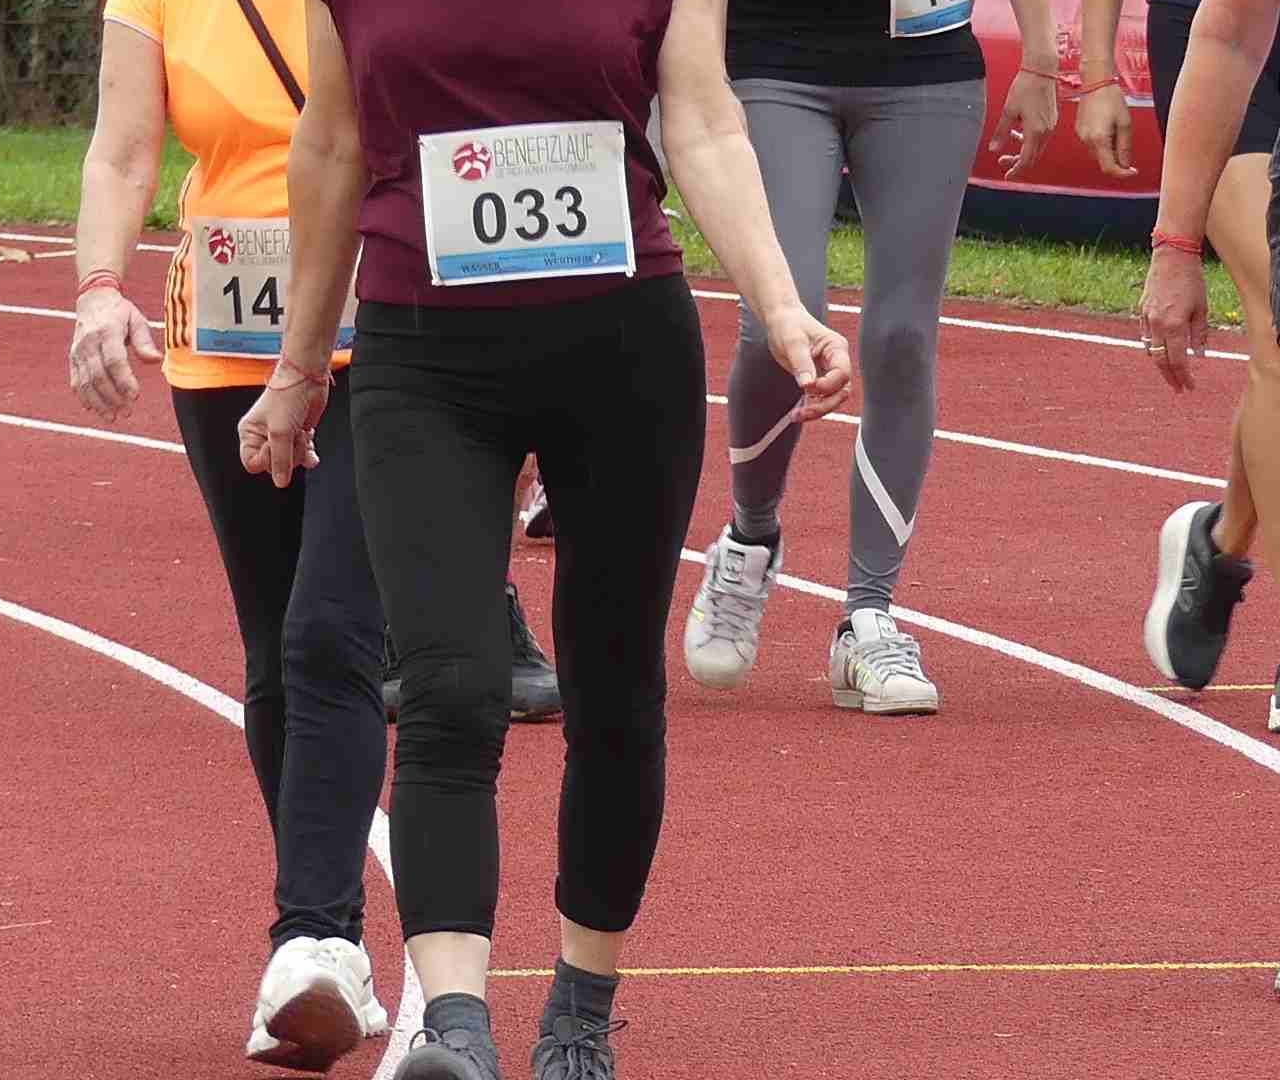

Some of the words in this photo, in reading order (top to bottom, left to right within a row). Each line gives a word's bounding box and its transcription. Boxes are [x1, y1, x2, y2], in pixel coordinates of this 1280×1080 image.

[494, 132, 594, 168] BENEFIZLAUF
[472, 185, 587, 245] 033
[223, 276, 284, 325] 14
